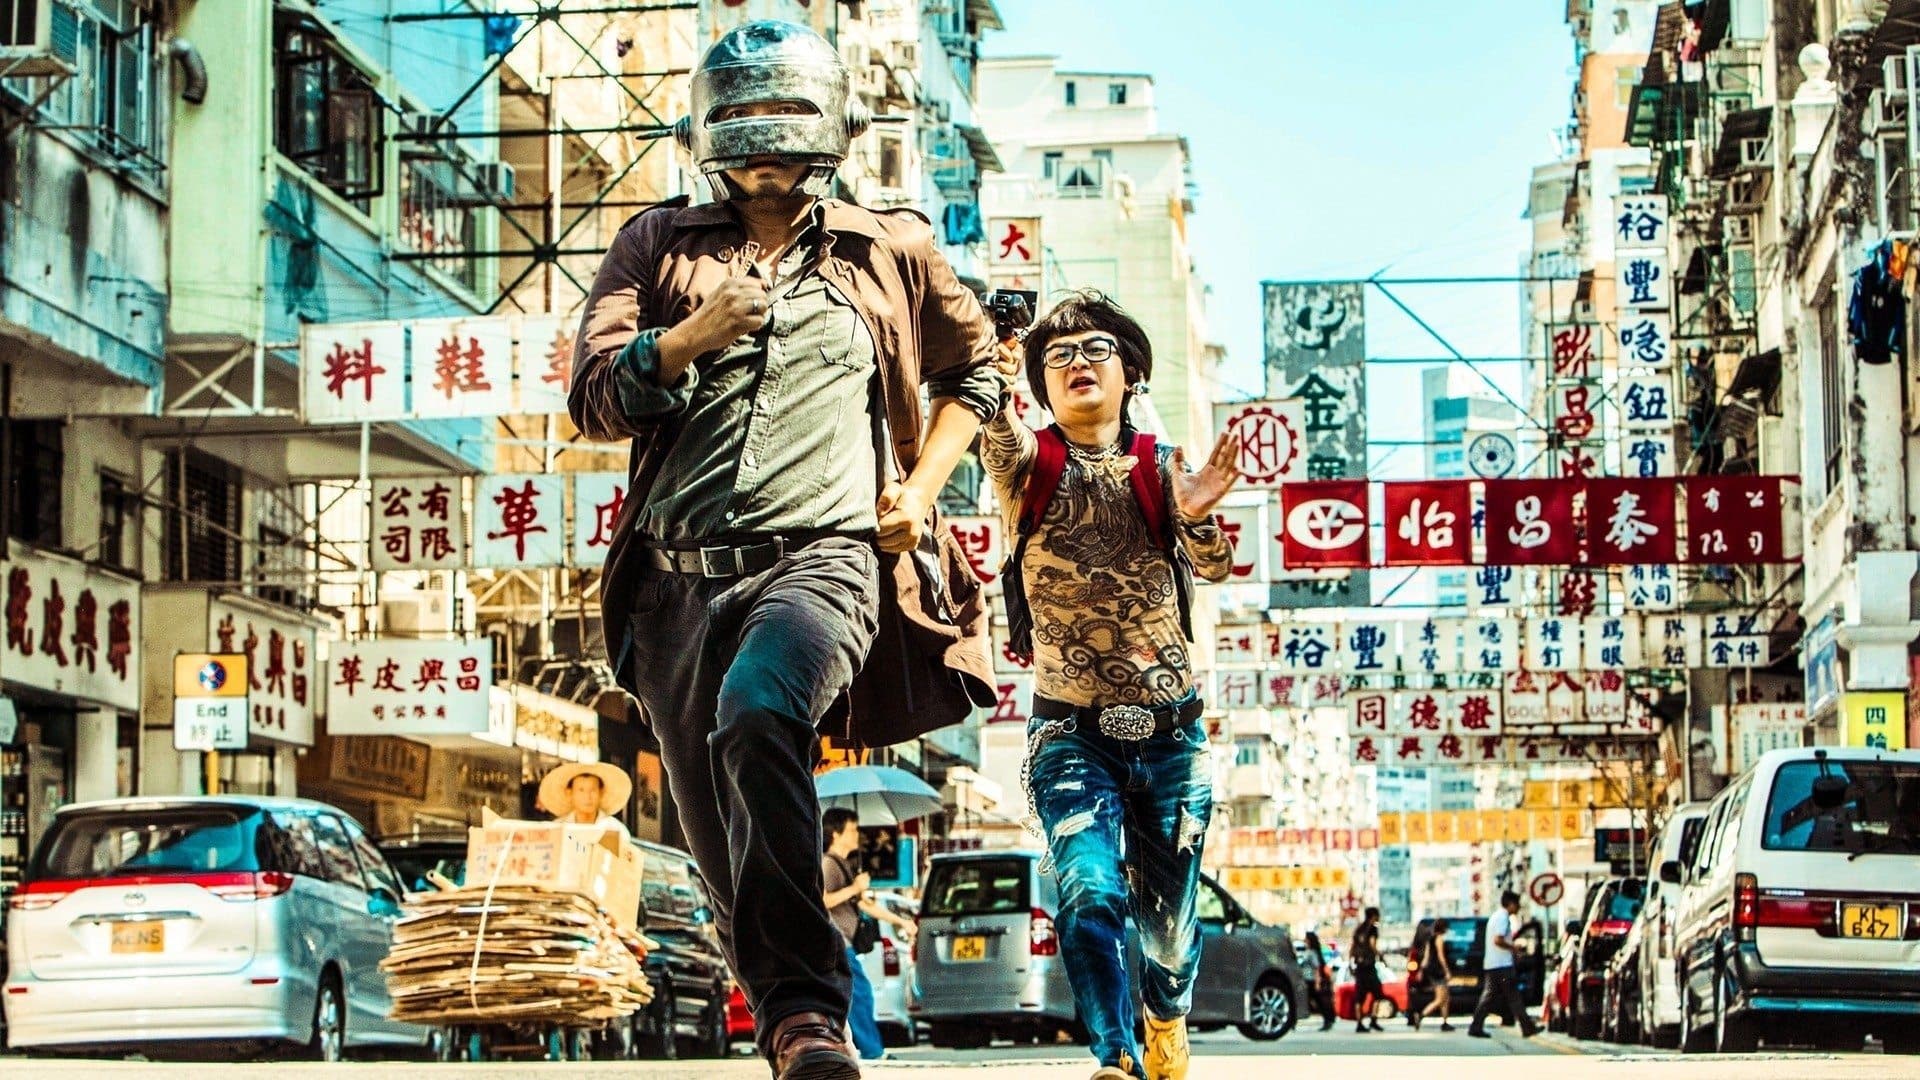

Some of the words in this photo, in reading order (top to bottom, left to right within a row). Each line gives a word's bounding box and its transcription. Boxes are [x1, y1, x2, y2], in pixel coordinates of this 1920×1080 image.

[1000, 223, 1031, 261] 大
[196, 704, 228, 717] End
[1852, 921, 1889, 938] 647
